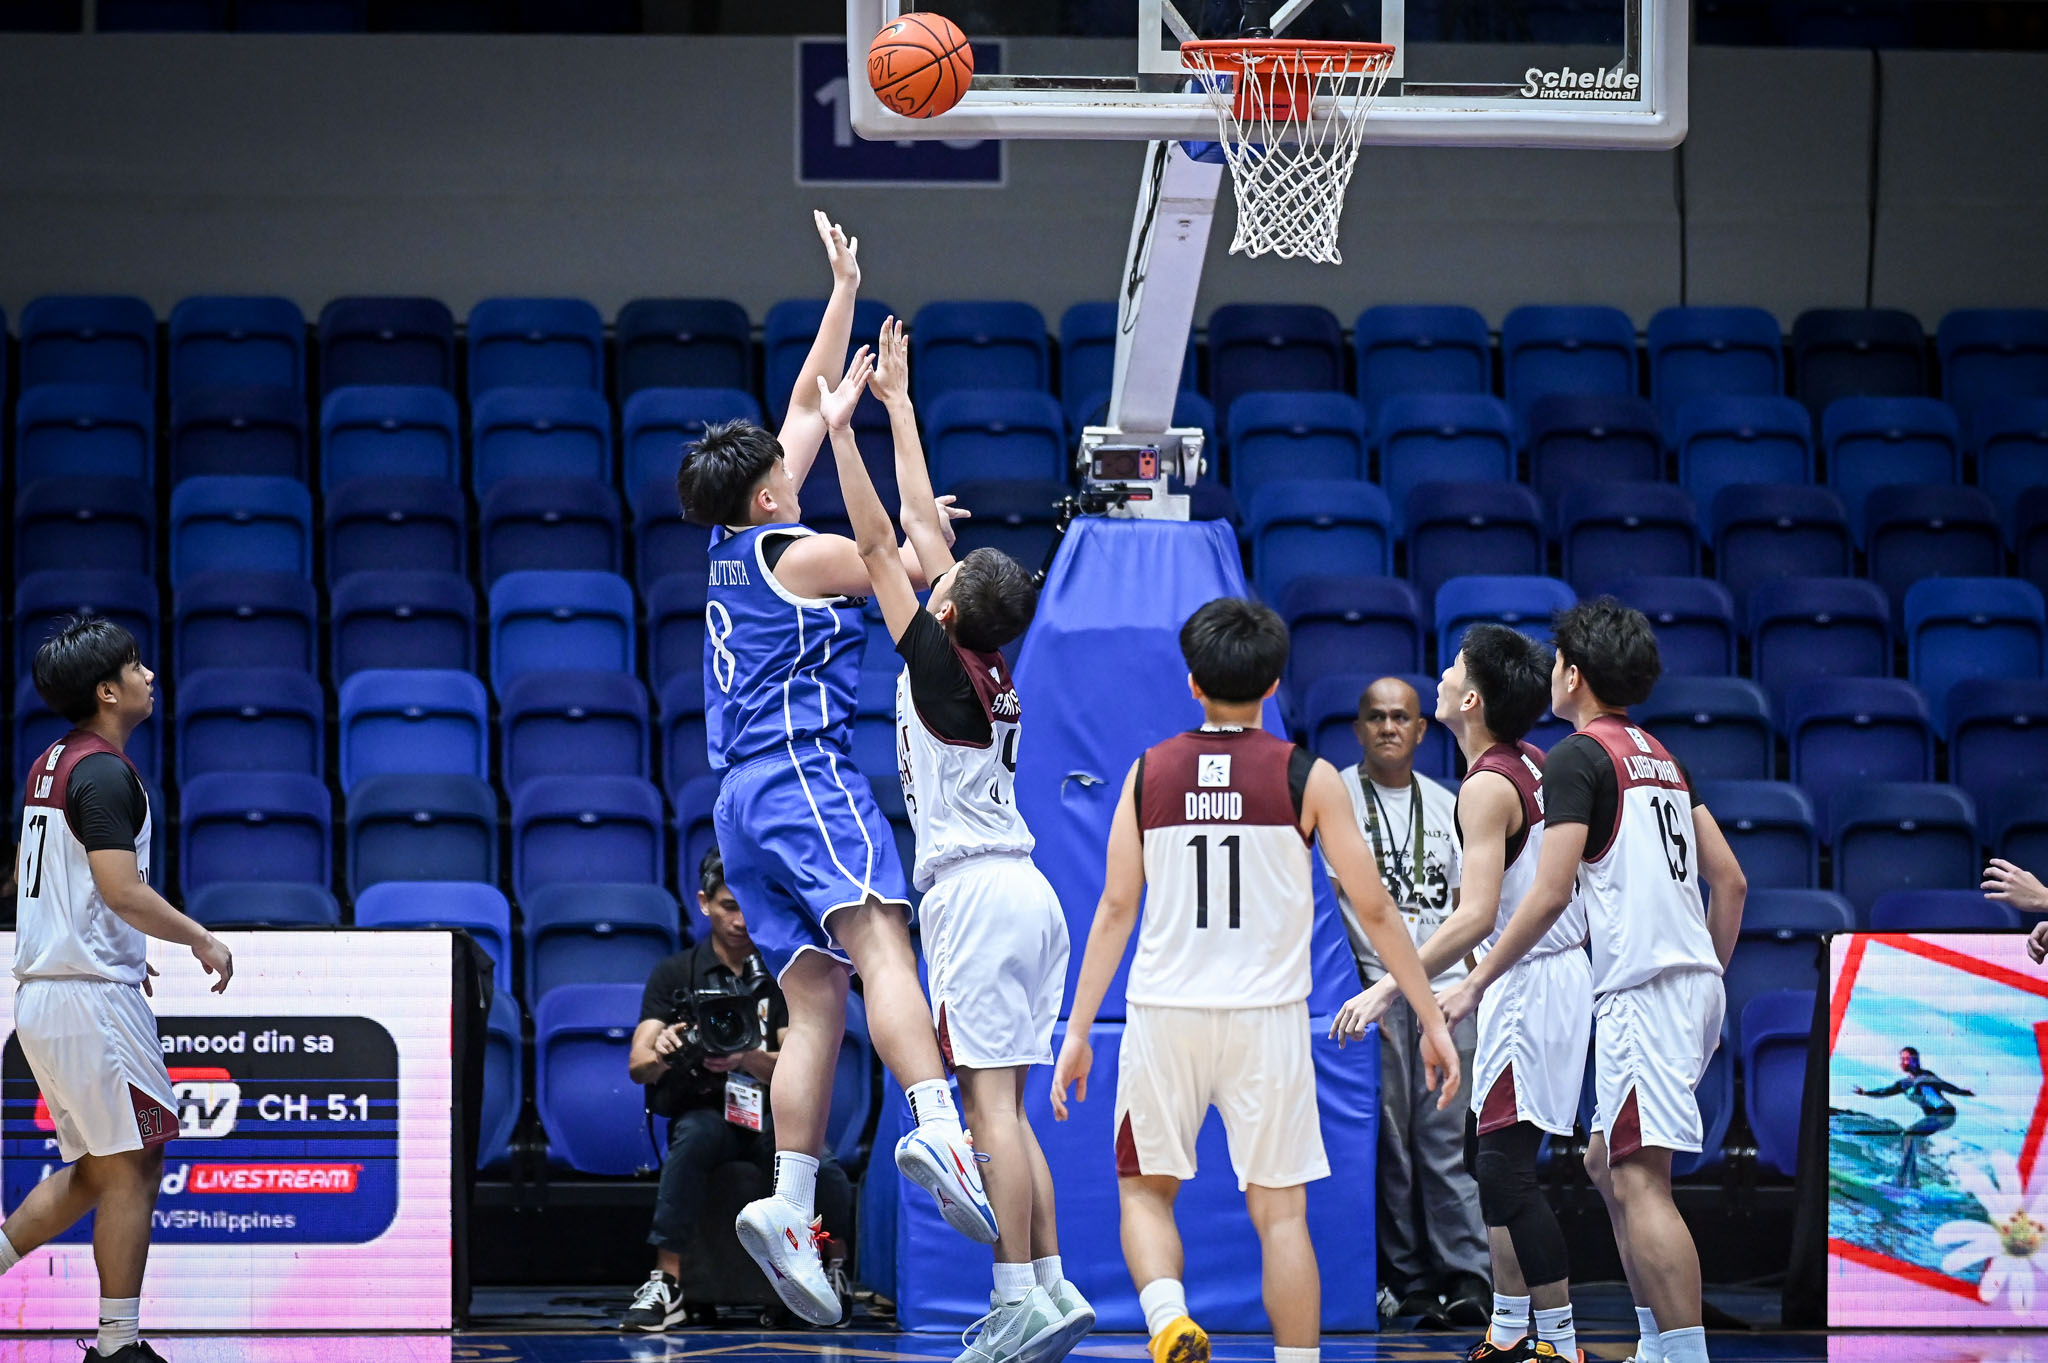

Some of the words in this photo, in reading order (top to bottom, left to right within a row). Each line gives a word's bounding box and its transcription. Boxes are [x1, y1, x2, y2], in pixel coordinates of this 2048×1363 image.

[1520, 66, 1640, 98] Schelde
[1539, 87, 1637, 100] international
[708, 560, 750, 586] AUTISTA
[705, 600, 736, 694] 8
[1185, 792, 1242, 820] DAVID
[1186, 834, 1240, 928] 11
[161, 1031, 246, 1053] anood
[252, 1029, 296, 1053] din
[302, 1034, 335, 1053] sa
[138, 1106, 163, 1137] 27
[257, 1093, 317, 1122] CH.
[327, 1093, 369, 1122] 5.1
[195, 1168, 351, 1190] LIVESTREAM
